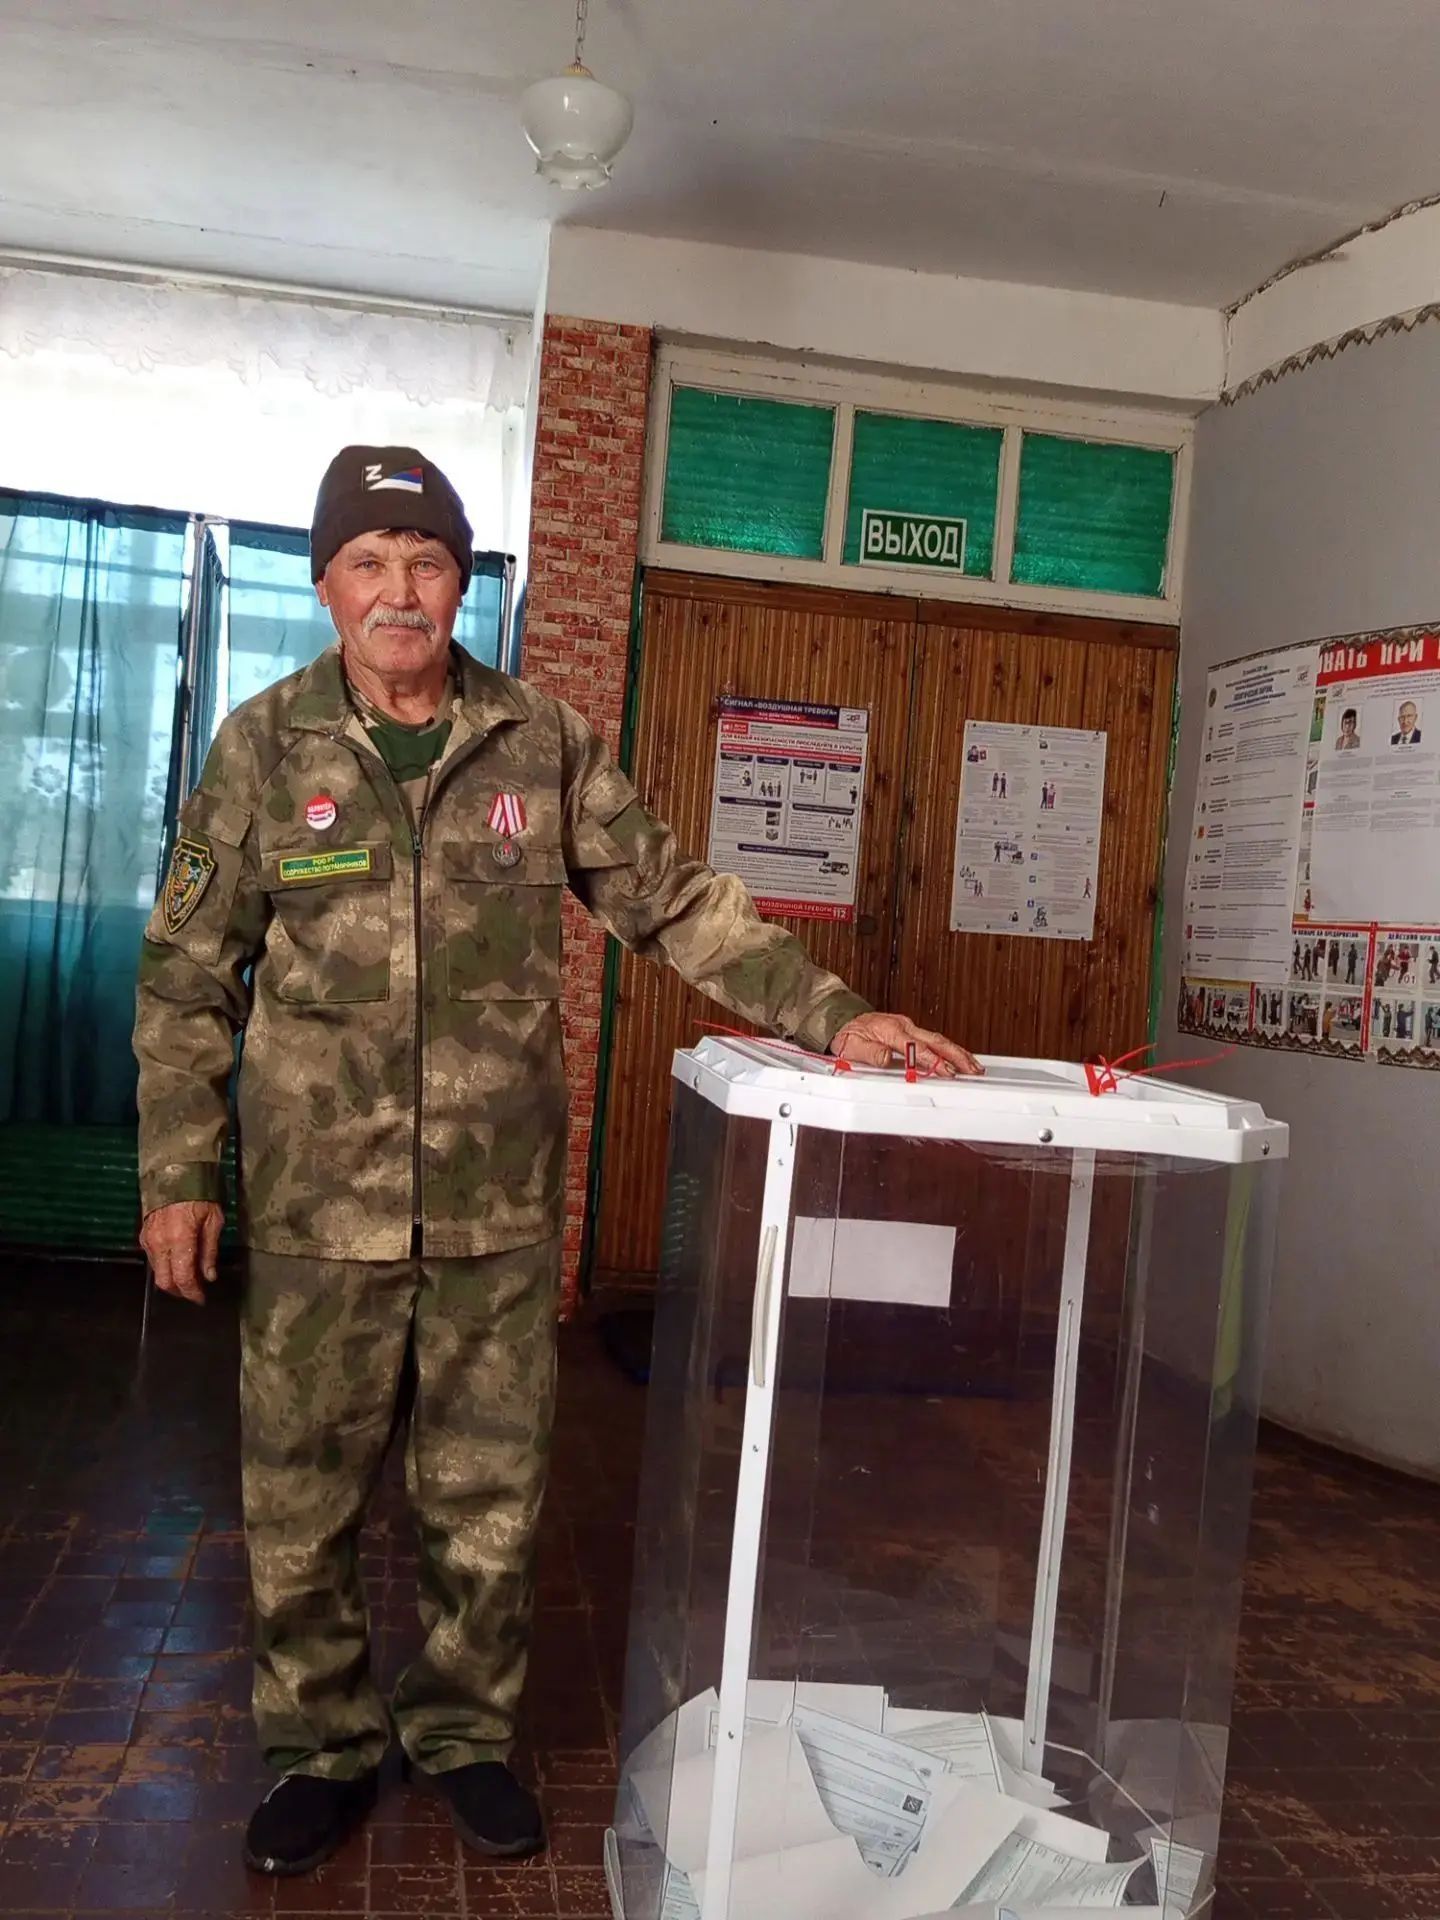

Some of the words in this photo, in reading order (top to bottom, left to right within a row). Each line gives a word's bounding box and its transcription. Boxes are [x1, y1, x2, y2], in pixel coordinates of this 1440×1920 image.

[365, 463, 383, 482] Z
[867, 518, 958, 563] ВЫХОД
[1380, 638, 1425, 666] ПРИ
[724, 698, 754, 708] СИГНАЛ
